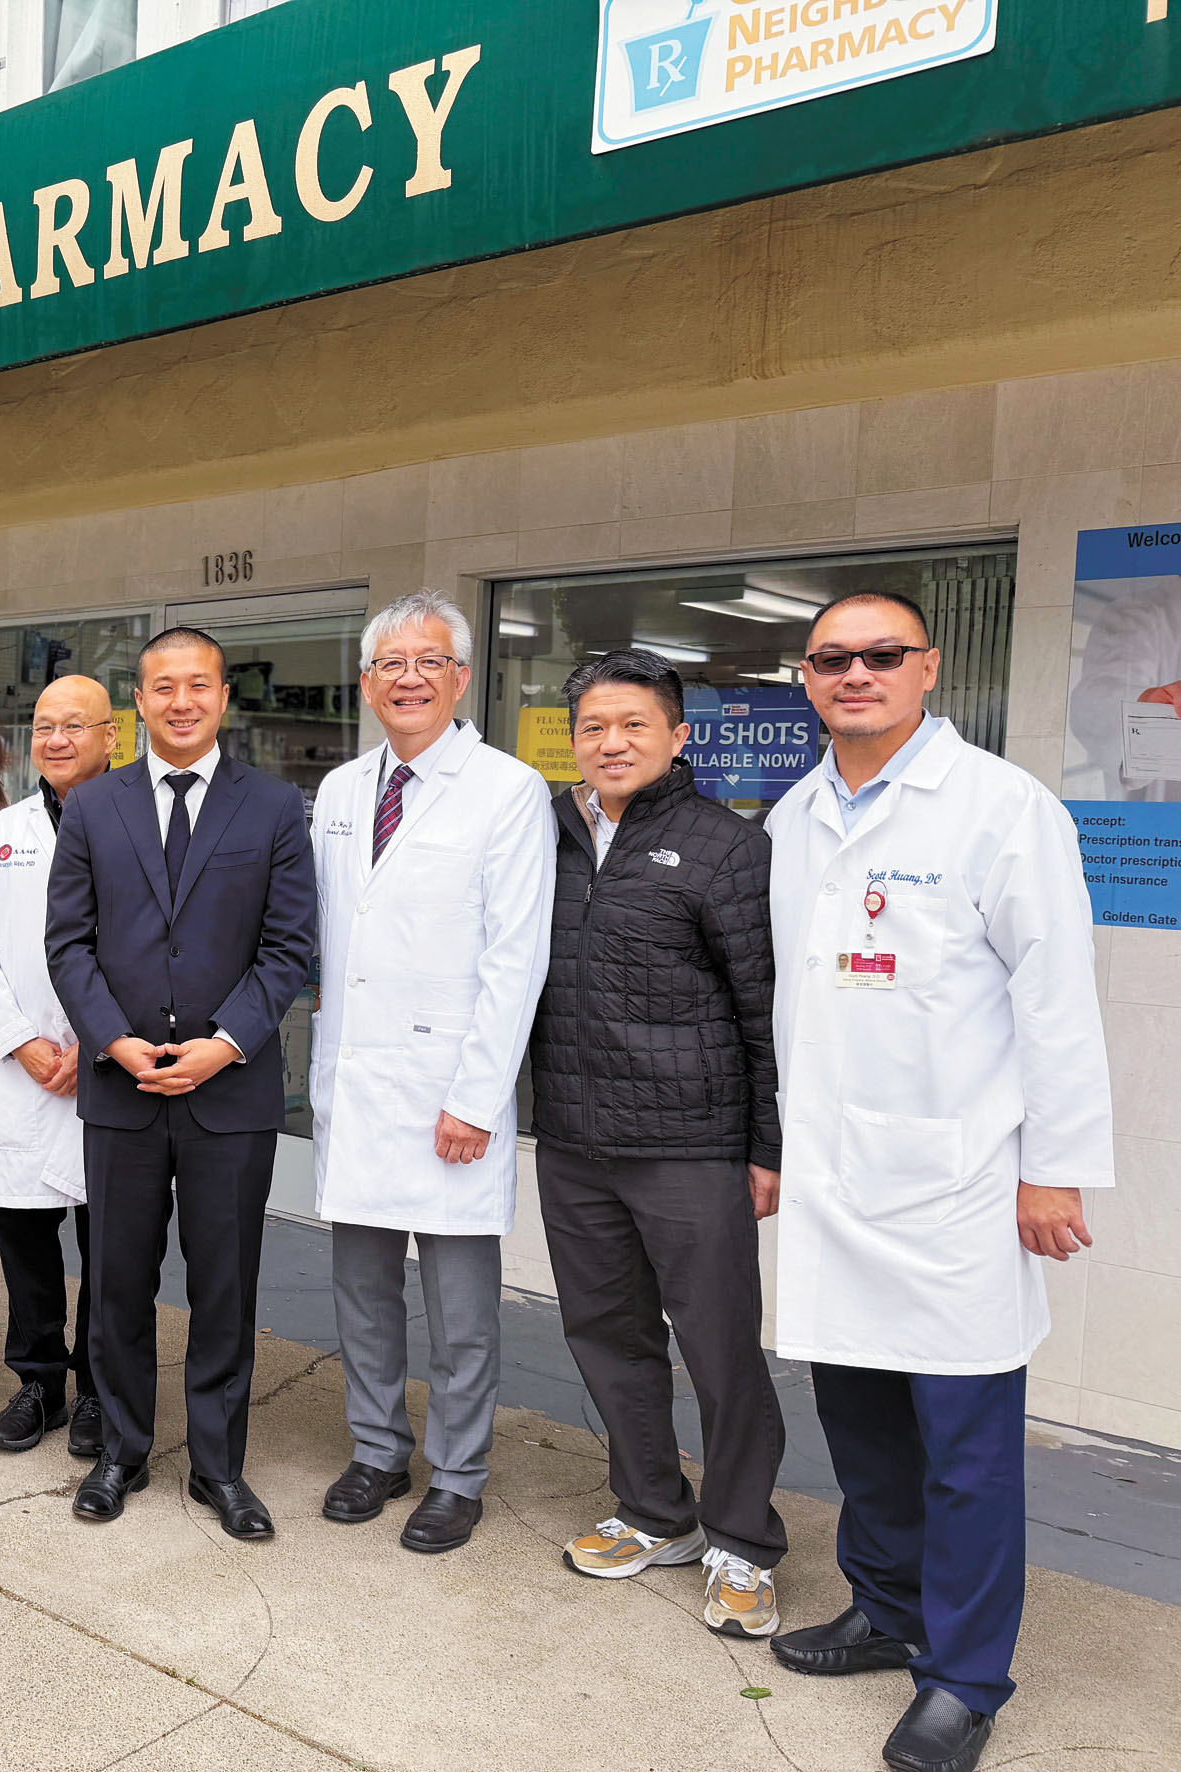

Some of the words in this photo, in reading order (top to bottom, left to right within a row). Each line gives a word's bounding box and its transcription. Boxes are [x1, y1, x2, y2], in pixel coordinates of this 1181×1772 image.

[728, 0, 909, 51] NEIGH
[725, 0, 967, 93] PHARMACY
[1127, 530, 1181, 548] Welco
[202, 550, 253, 588] 1836
[536, 716, 555, 725] FLU
[719, 722, 809, 745] SHOTS
[679, 753, 754, 768] AILABLE
[759, 753, 806, 768] NOW!
[1082, 816, 1126, 828] accept:
[1079, 833, 1150, 848] Prescription
[1080, 853, 1117, 866] Doctor
[866, 868, 887, 881] Scott
[888, 869, 923, 886] Huang,
[1109, 873, 1169, 887] insurance
[1102, 910, 1145, 923] Golden
[1148, 913, 1177, 926] Gate
